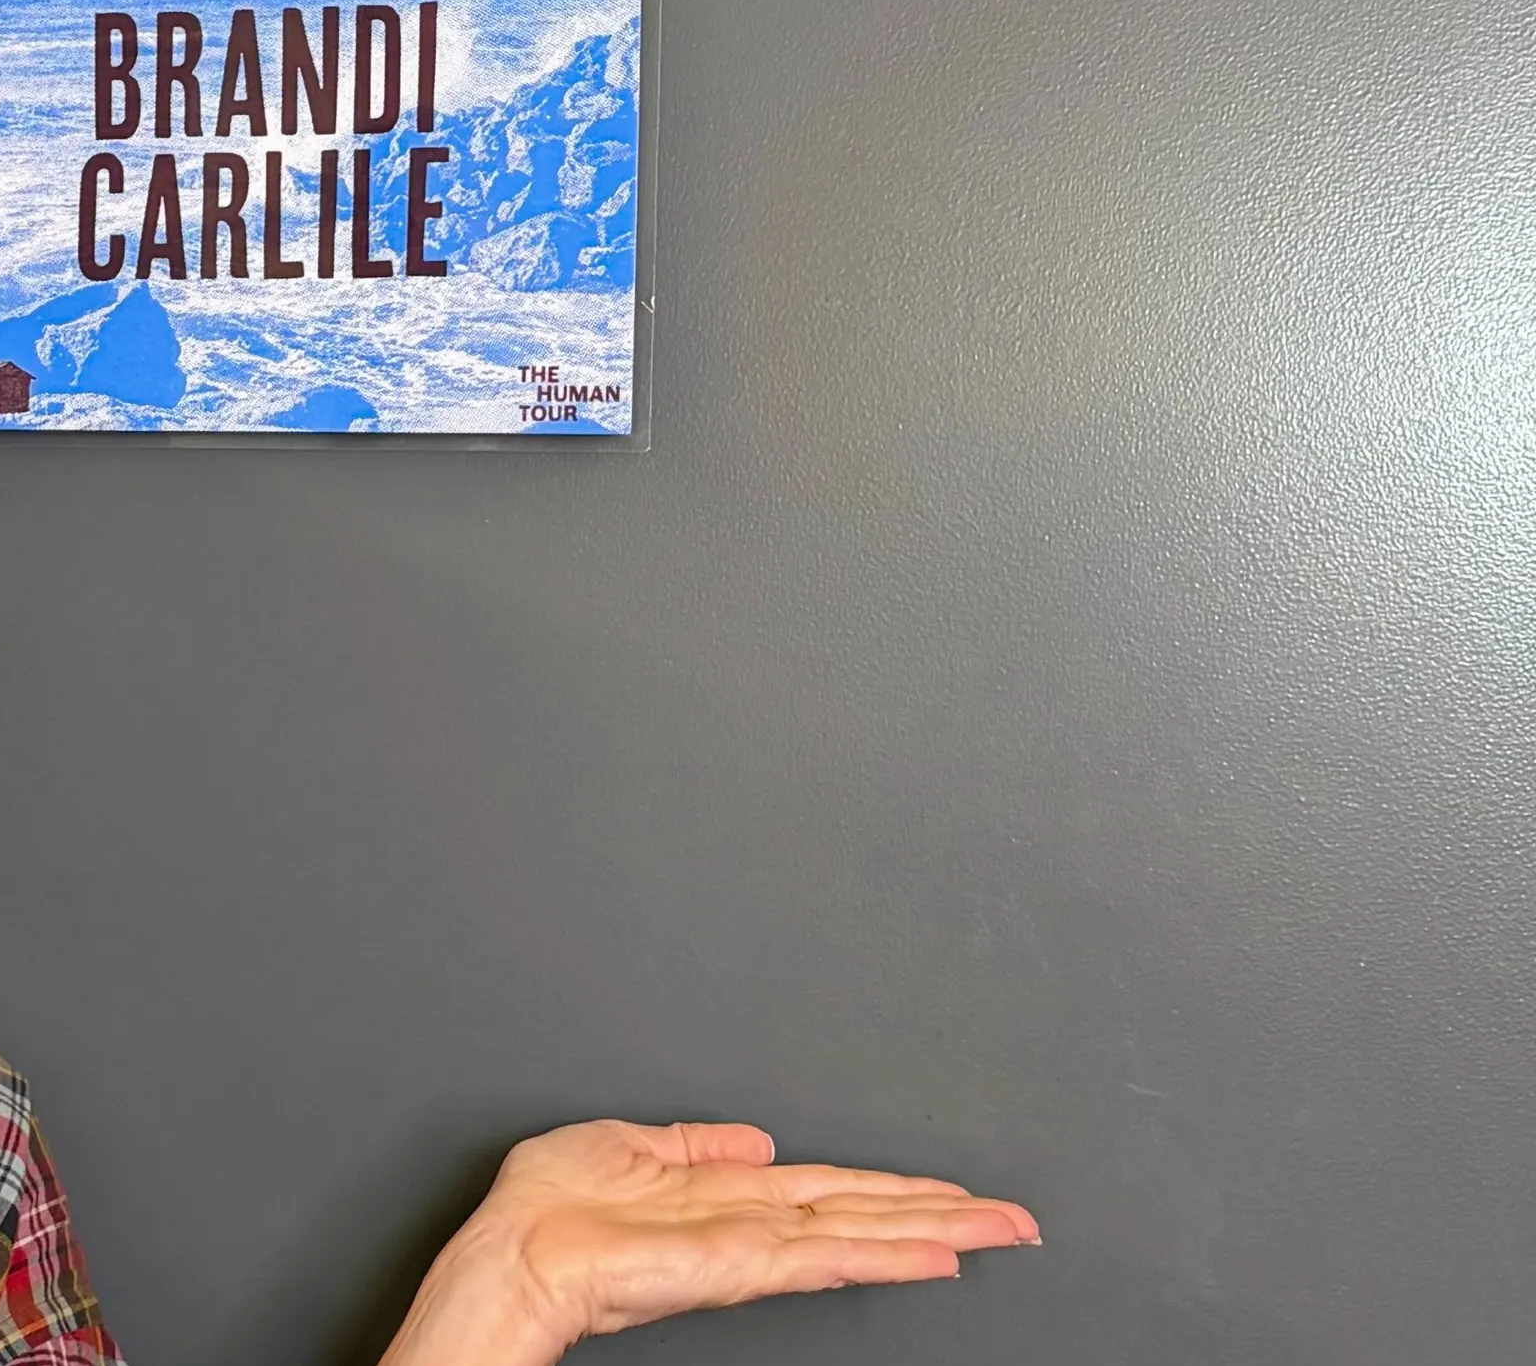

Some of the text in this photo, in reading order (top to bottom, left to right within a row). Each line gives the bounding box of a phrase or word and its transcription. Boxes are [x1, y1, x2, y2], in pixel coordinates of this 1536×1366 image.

[94, 1, 438, 141] BRANDI
[77, 147, 450, 282] CARLILE
[517, 365, 560, 383] THE
[537, 384, 621, 403] HUMAN
[518, 404, 578, 422] TOUR
